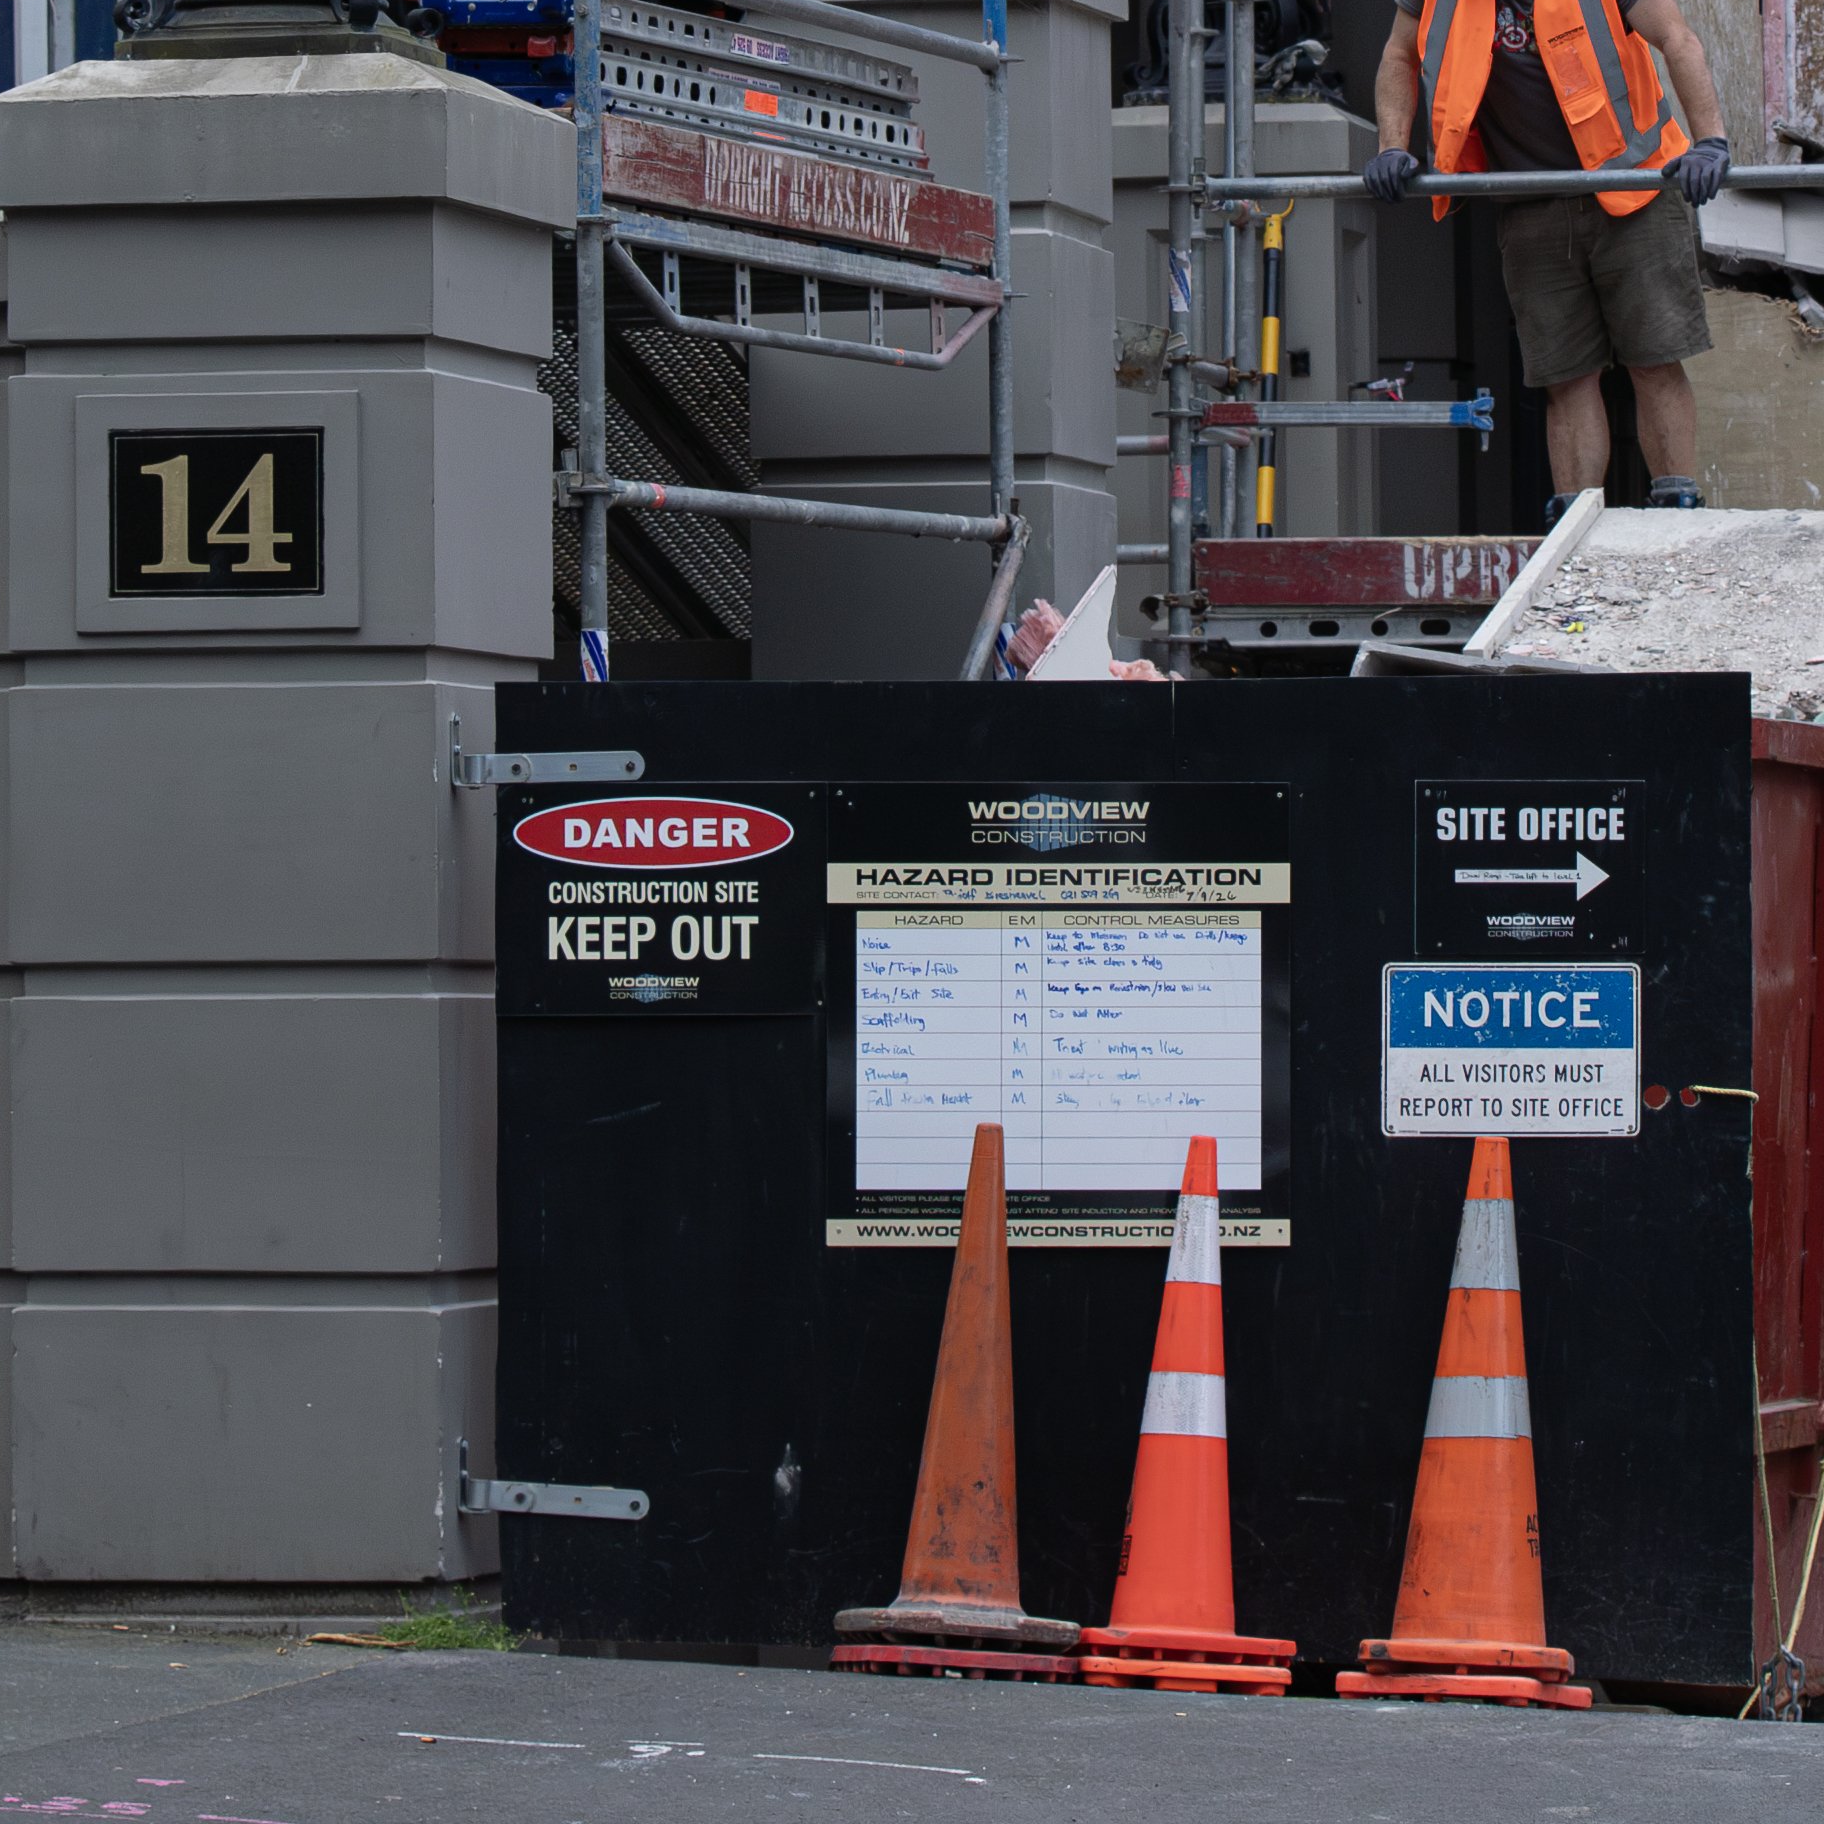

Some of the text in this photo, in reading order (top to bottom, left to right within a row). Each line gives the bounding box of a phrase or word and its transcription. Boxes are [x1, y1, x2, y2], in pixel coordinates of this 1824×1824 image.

[703, 135, 783, 217] UPRIGHT
[140, 452, 293, 574] 14
[967, 801, 1151, 819] WOODVIEW
[1436, 807, 1625, 841] SITE OFFICE
[564, 817, 751, 848] DANGER
[970, 829, 1147, 845] CONSTRUCTION
[855, 867, 1262, 887] HAZARD IDENTIFICATION
[547, 880, 760, 904] CONSTRUCTION SITE
[855, 891, 880, 899] SITE
[894, 915, 964, 925] HAZARD
[1008, 915, 1036, 925] EM
[1063, 915, 1240, 926] CONTROL MEASURES
[1486, 915, 1576, 927] WOODVIEW
[548, 915, 760, 961] KEEP OUT
[1487, 929, 1574, 938] CONSTRUCTION
[1014, 936, 1031, 949] M
[1014, 962, 1029, 975] M
[608, 977, 700, 988] WOODVIEW
[609, 991, 699, 1000] CONSTRUCTION
[1014, 988, 1028, 1002] M
[1423, 990, 1601, 1029] NOTICE
[1013, 1012, 1028, 1028] M
[1419, 1063, 1605, 1083] ALL VISITORS MUST
[1011, 1093, 1026, 1105] M
[1399, 1096, 1625, 1118] REPORT TO SITE OFFICE
